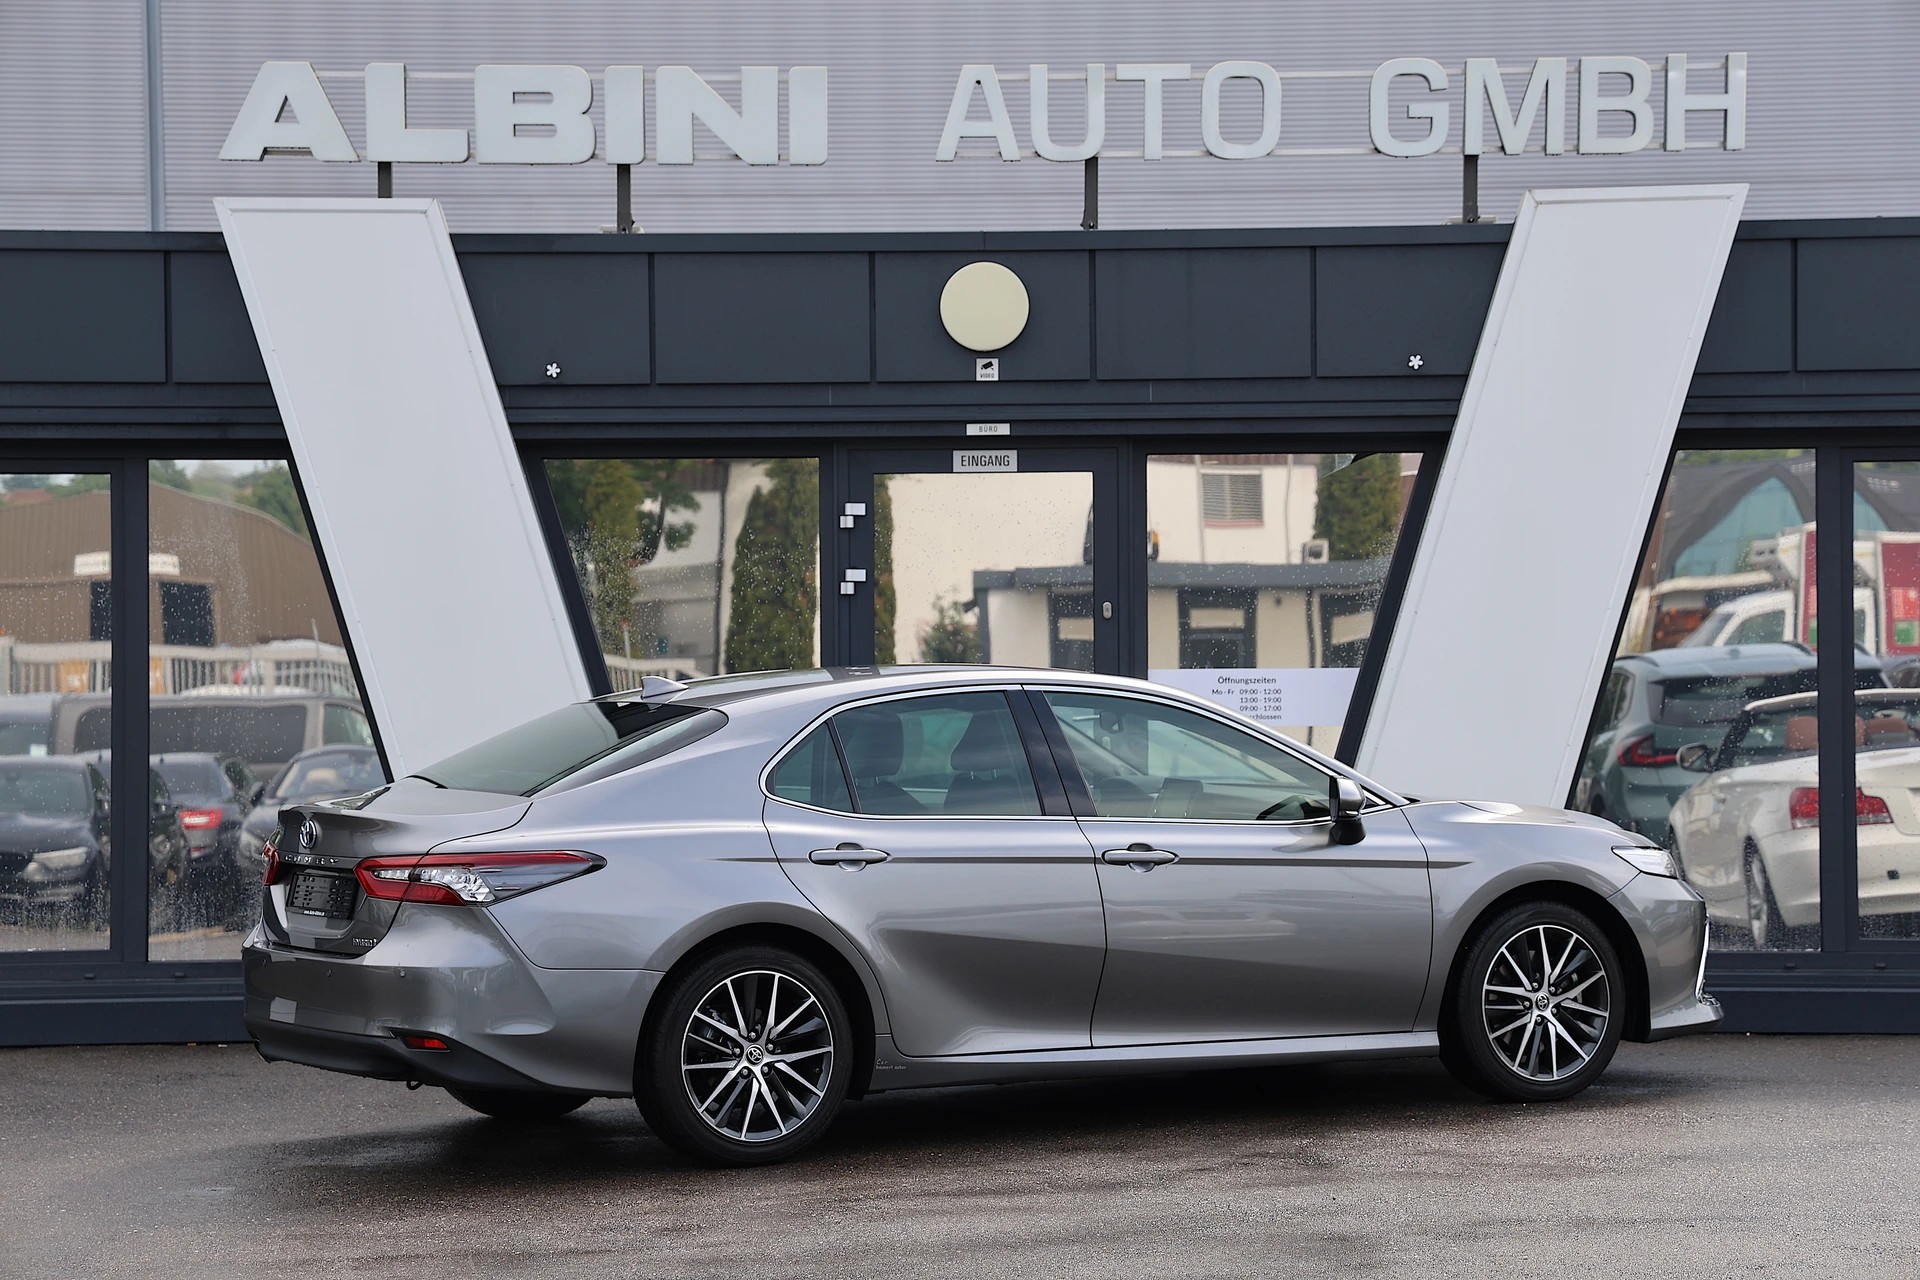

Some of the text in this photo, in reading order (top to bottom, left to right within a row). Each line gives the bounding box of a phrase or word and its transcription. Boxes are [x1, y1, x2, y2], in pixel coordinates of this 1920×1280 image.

[218, 51, 1748, 166] ALBINI AUTO GMBH
[961, 455, 1010, 467] EINGANG
